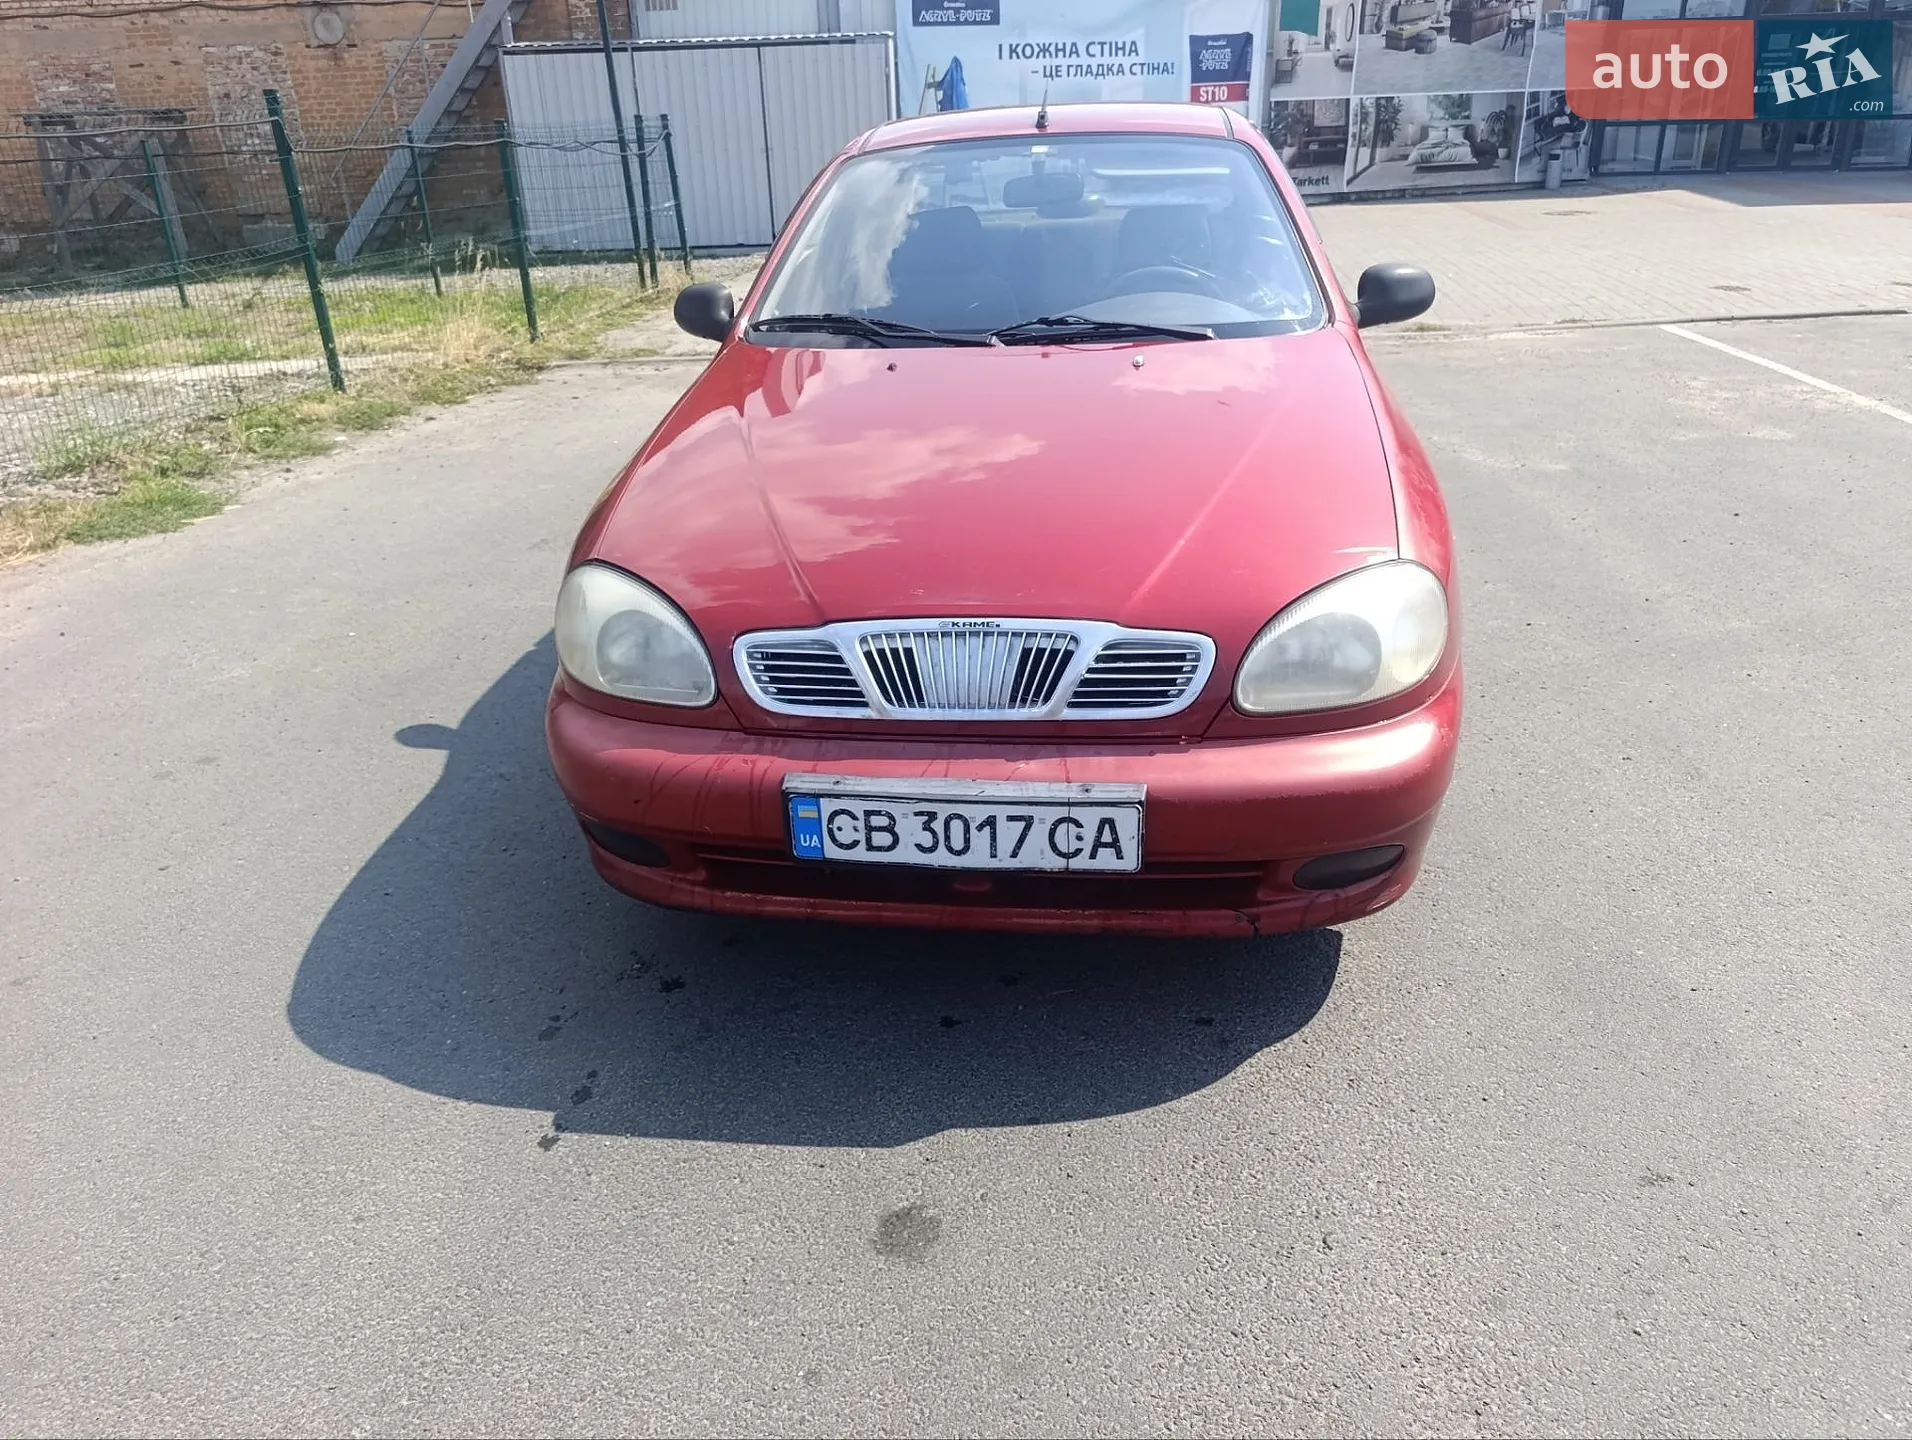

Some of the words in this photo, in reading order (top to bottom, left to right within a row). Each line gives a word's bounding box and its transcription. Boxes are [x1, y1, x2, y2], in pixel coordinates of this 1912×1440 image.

[998, 43, 1003, 60] І
[1008, 42, 1080, 60] КОЖНА
[1085, 40, 1140, 58] СТІНА
[1043, 64, 1063, 81] ЦЕ
[1067, 62, 1125, 80] ГЛАДКА
[1129, 61, 1175, 77] СТІНА!
[1200, 86, 1228, 102] ST10
[800, 833, 821, 848] UA
[826, 808, 900, 853] CB
[913, 810, 1035, 859] 3017
[1048, 816, 1125, 861] CA
